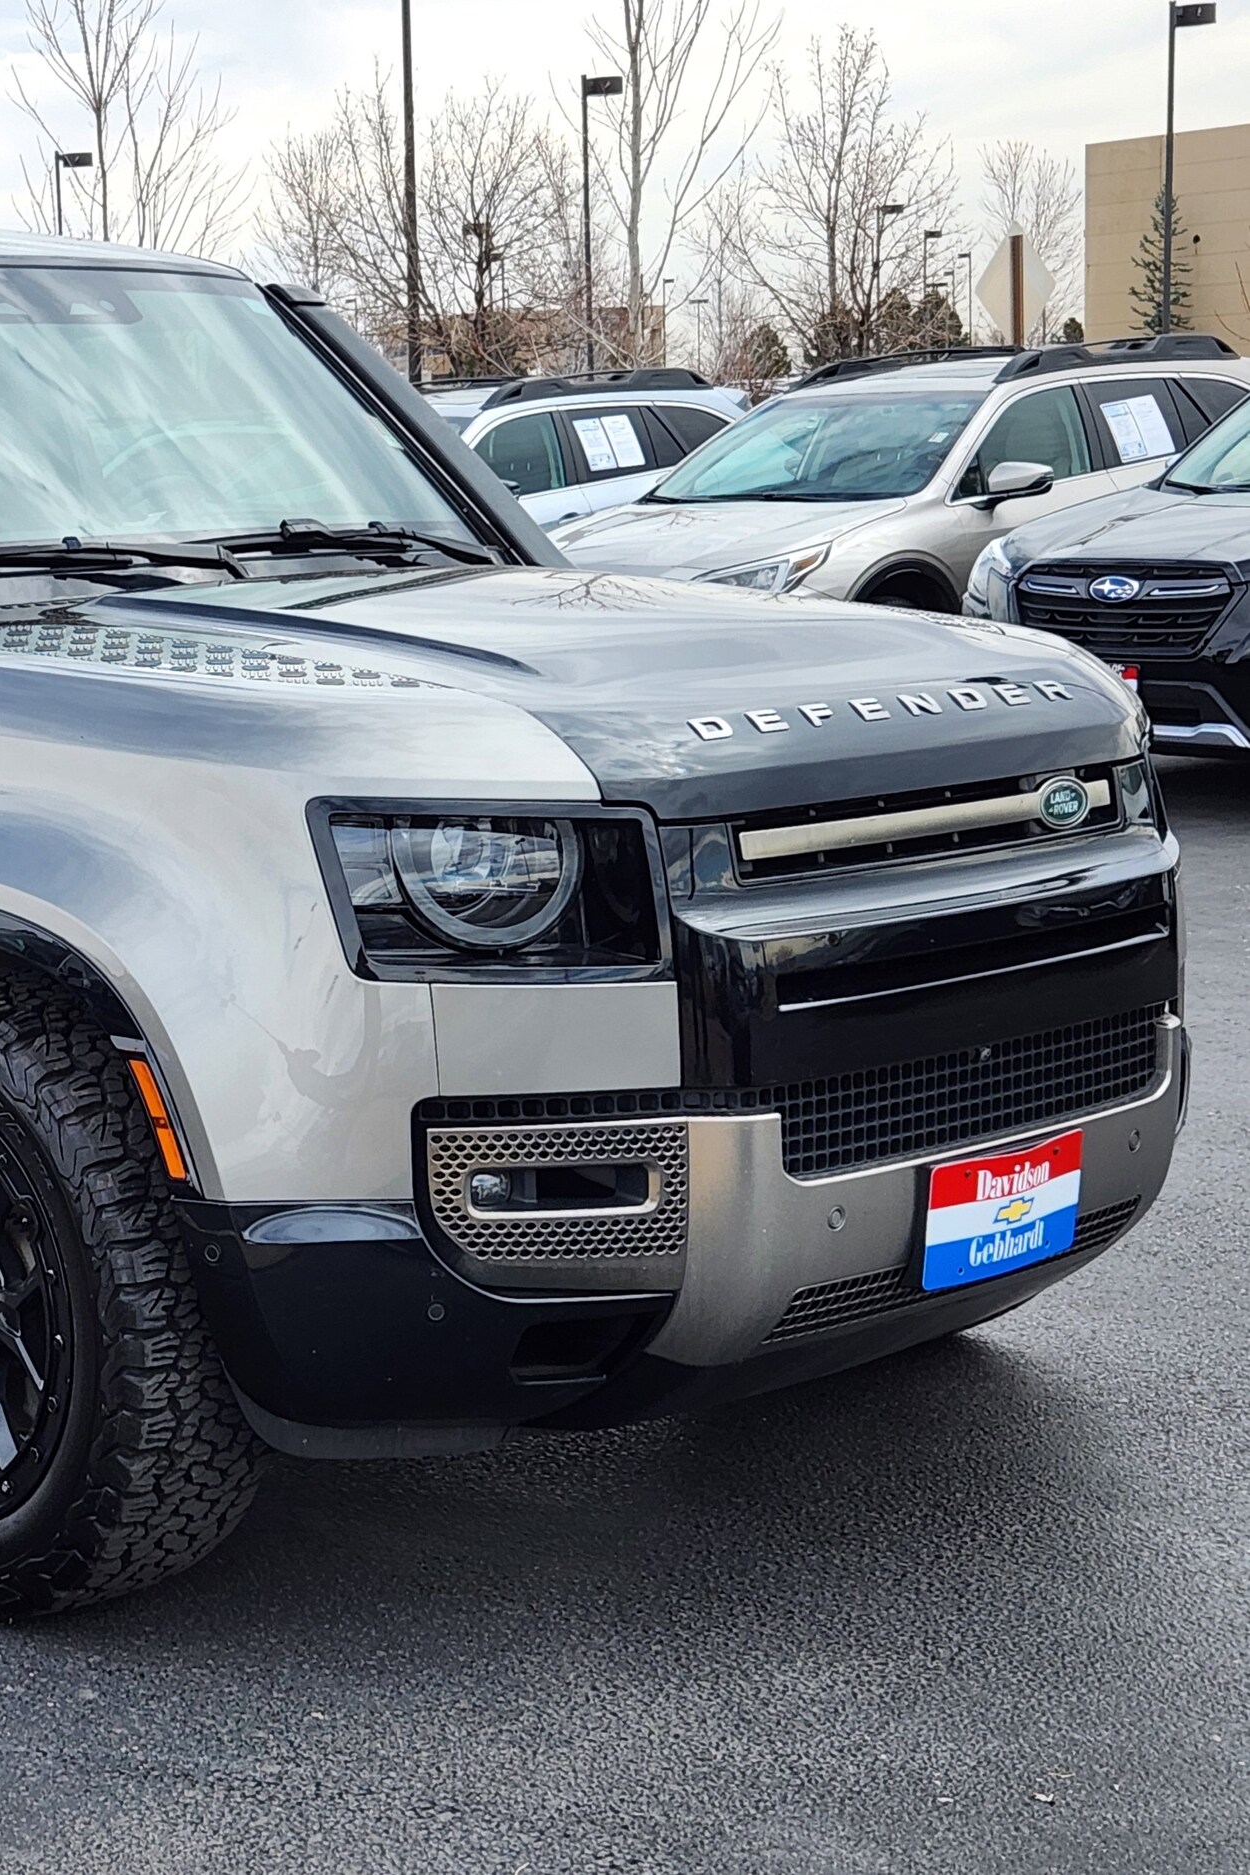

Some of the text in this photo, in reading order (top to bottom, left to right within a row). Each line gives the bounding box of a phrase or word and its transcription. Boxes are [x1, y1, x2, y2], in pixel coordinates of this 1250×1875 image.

[686, 680, 1074, 741] DEFENDER
[1049, 789, 1071, 804] LAND
[1052, 800, 1079, 816] ROVER
[976, 1160, 1050, 1201] Davidson
[970, 1220, 1045, 1267] Gebhardt
